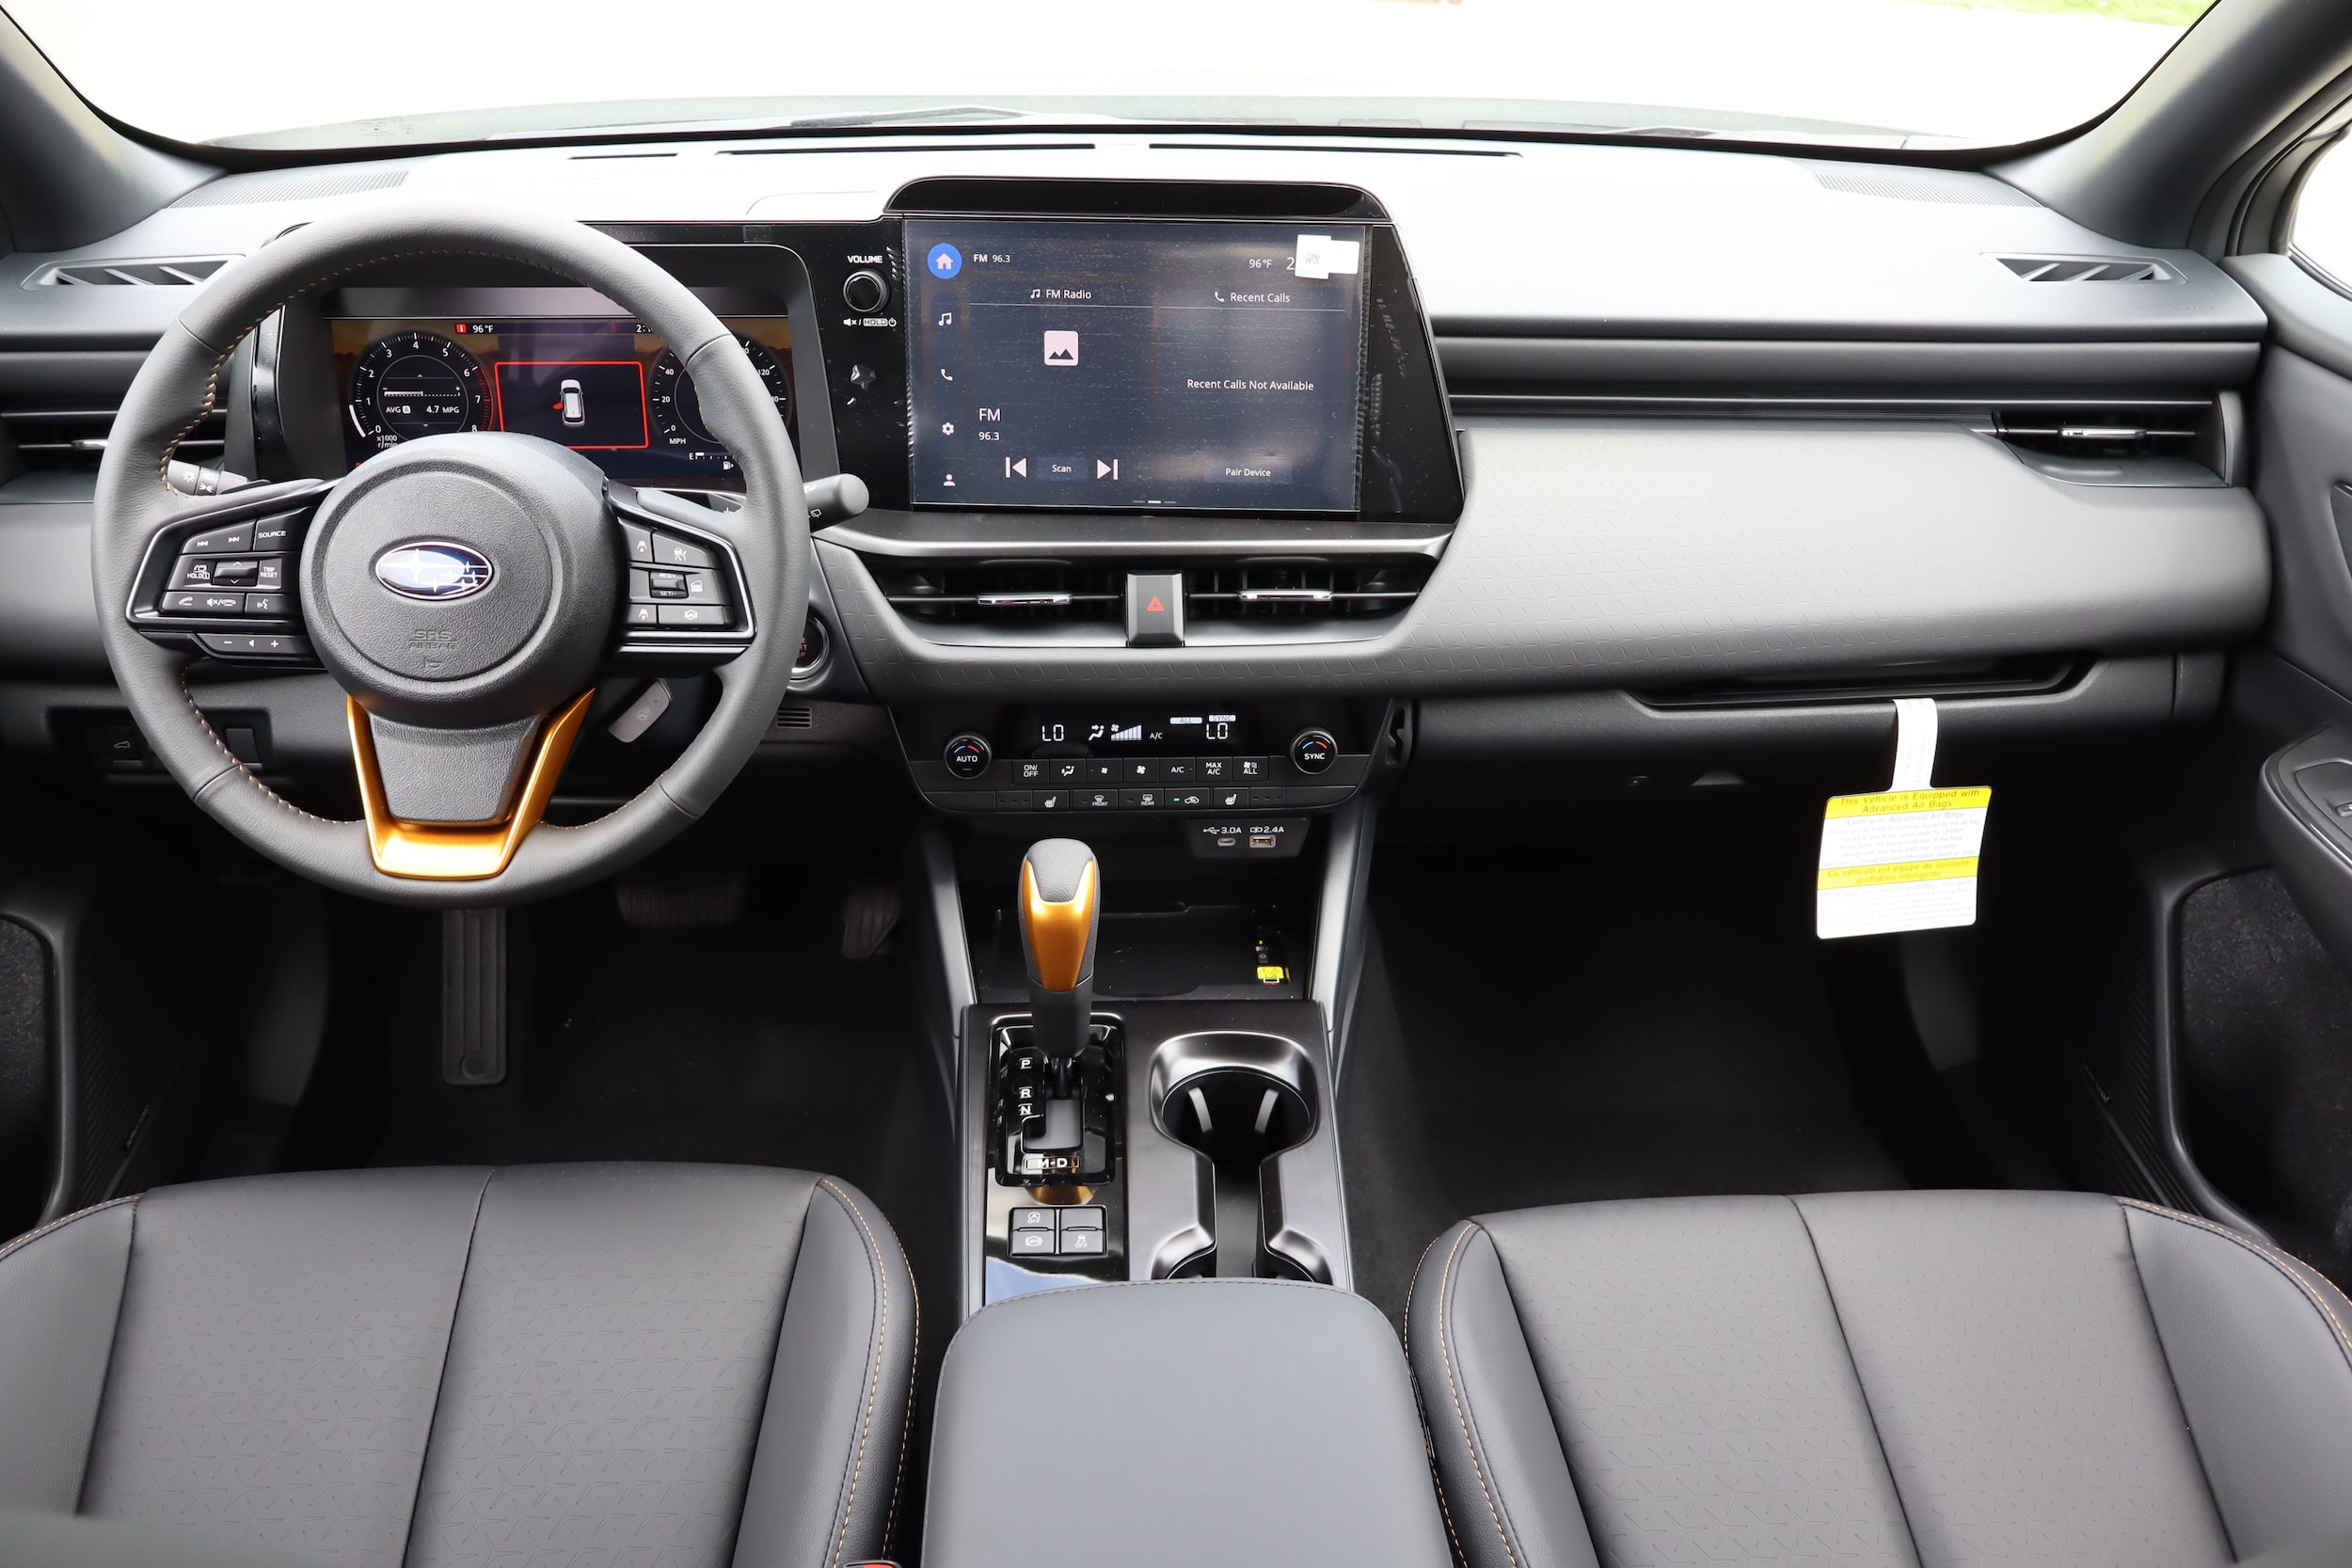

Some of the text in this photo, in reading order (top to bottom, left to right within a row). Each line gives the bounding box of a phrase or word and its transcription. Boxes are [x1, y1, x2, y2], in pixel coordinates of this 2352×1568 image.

[847, 255, 883, 263] VOLUME
[973, 254, 1010, 263] FM 96.3
[1248, 259, 1272, 269] 96°F
[1045, 290, 1091, 299] FM Radio
[1231, 293, 1291, 303] Recent Calls
[413, 341, 420, 349] 4
[386, 349, 392, 357] 3
[442, 348, 449, 356] 5
[368, 370, 374, 378] 2
[464, 369, 470, 377] 6
[1187, 379, 1314, 391] Recent Calls Not Available
[366, 397, 371, 405] 1
[475, 395, 481, 404] 7
[386, 405, 401, 414] AVG
[426, 404, 460, 414] 4.7 MPG
[978, 408, 1001, 421] FM
[374, 424, 382, 433] 0
[978, 432, 1000, 441] 96.3
[1052, 464, 1072, 473] Scan
[1225, 467, 1271, 477] Pair Device
[258, 530, 287, 539] SOURCE
[1149, 732, 1164, 740] A/C
[1171, 766, 1185, 774] A/C
[1864, 794, 1897, 803] Vehicle
[1913, 790, 1958, 800] Equipped
[1961, 789, 1980, 798] with
[1863, 803, 1909, 814] Advanced
[1929, 800, 1953, 809] Bags
[1220, 826, 1243, 834] 3.0A
[1021, 1059, 1032, 1069] P
[1020, 1088, 1032, 1099] R
[1020, 1104, 1032, 1116] N
